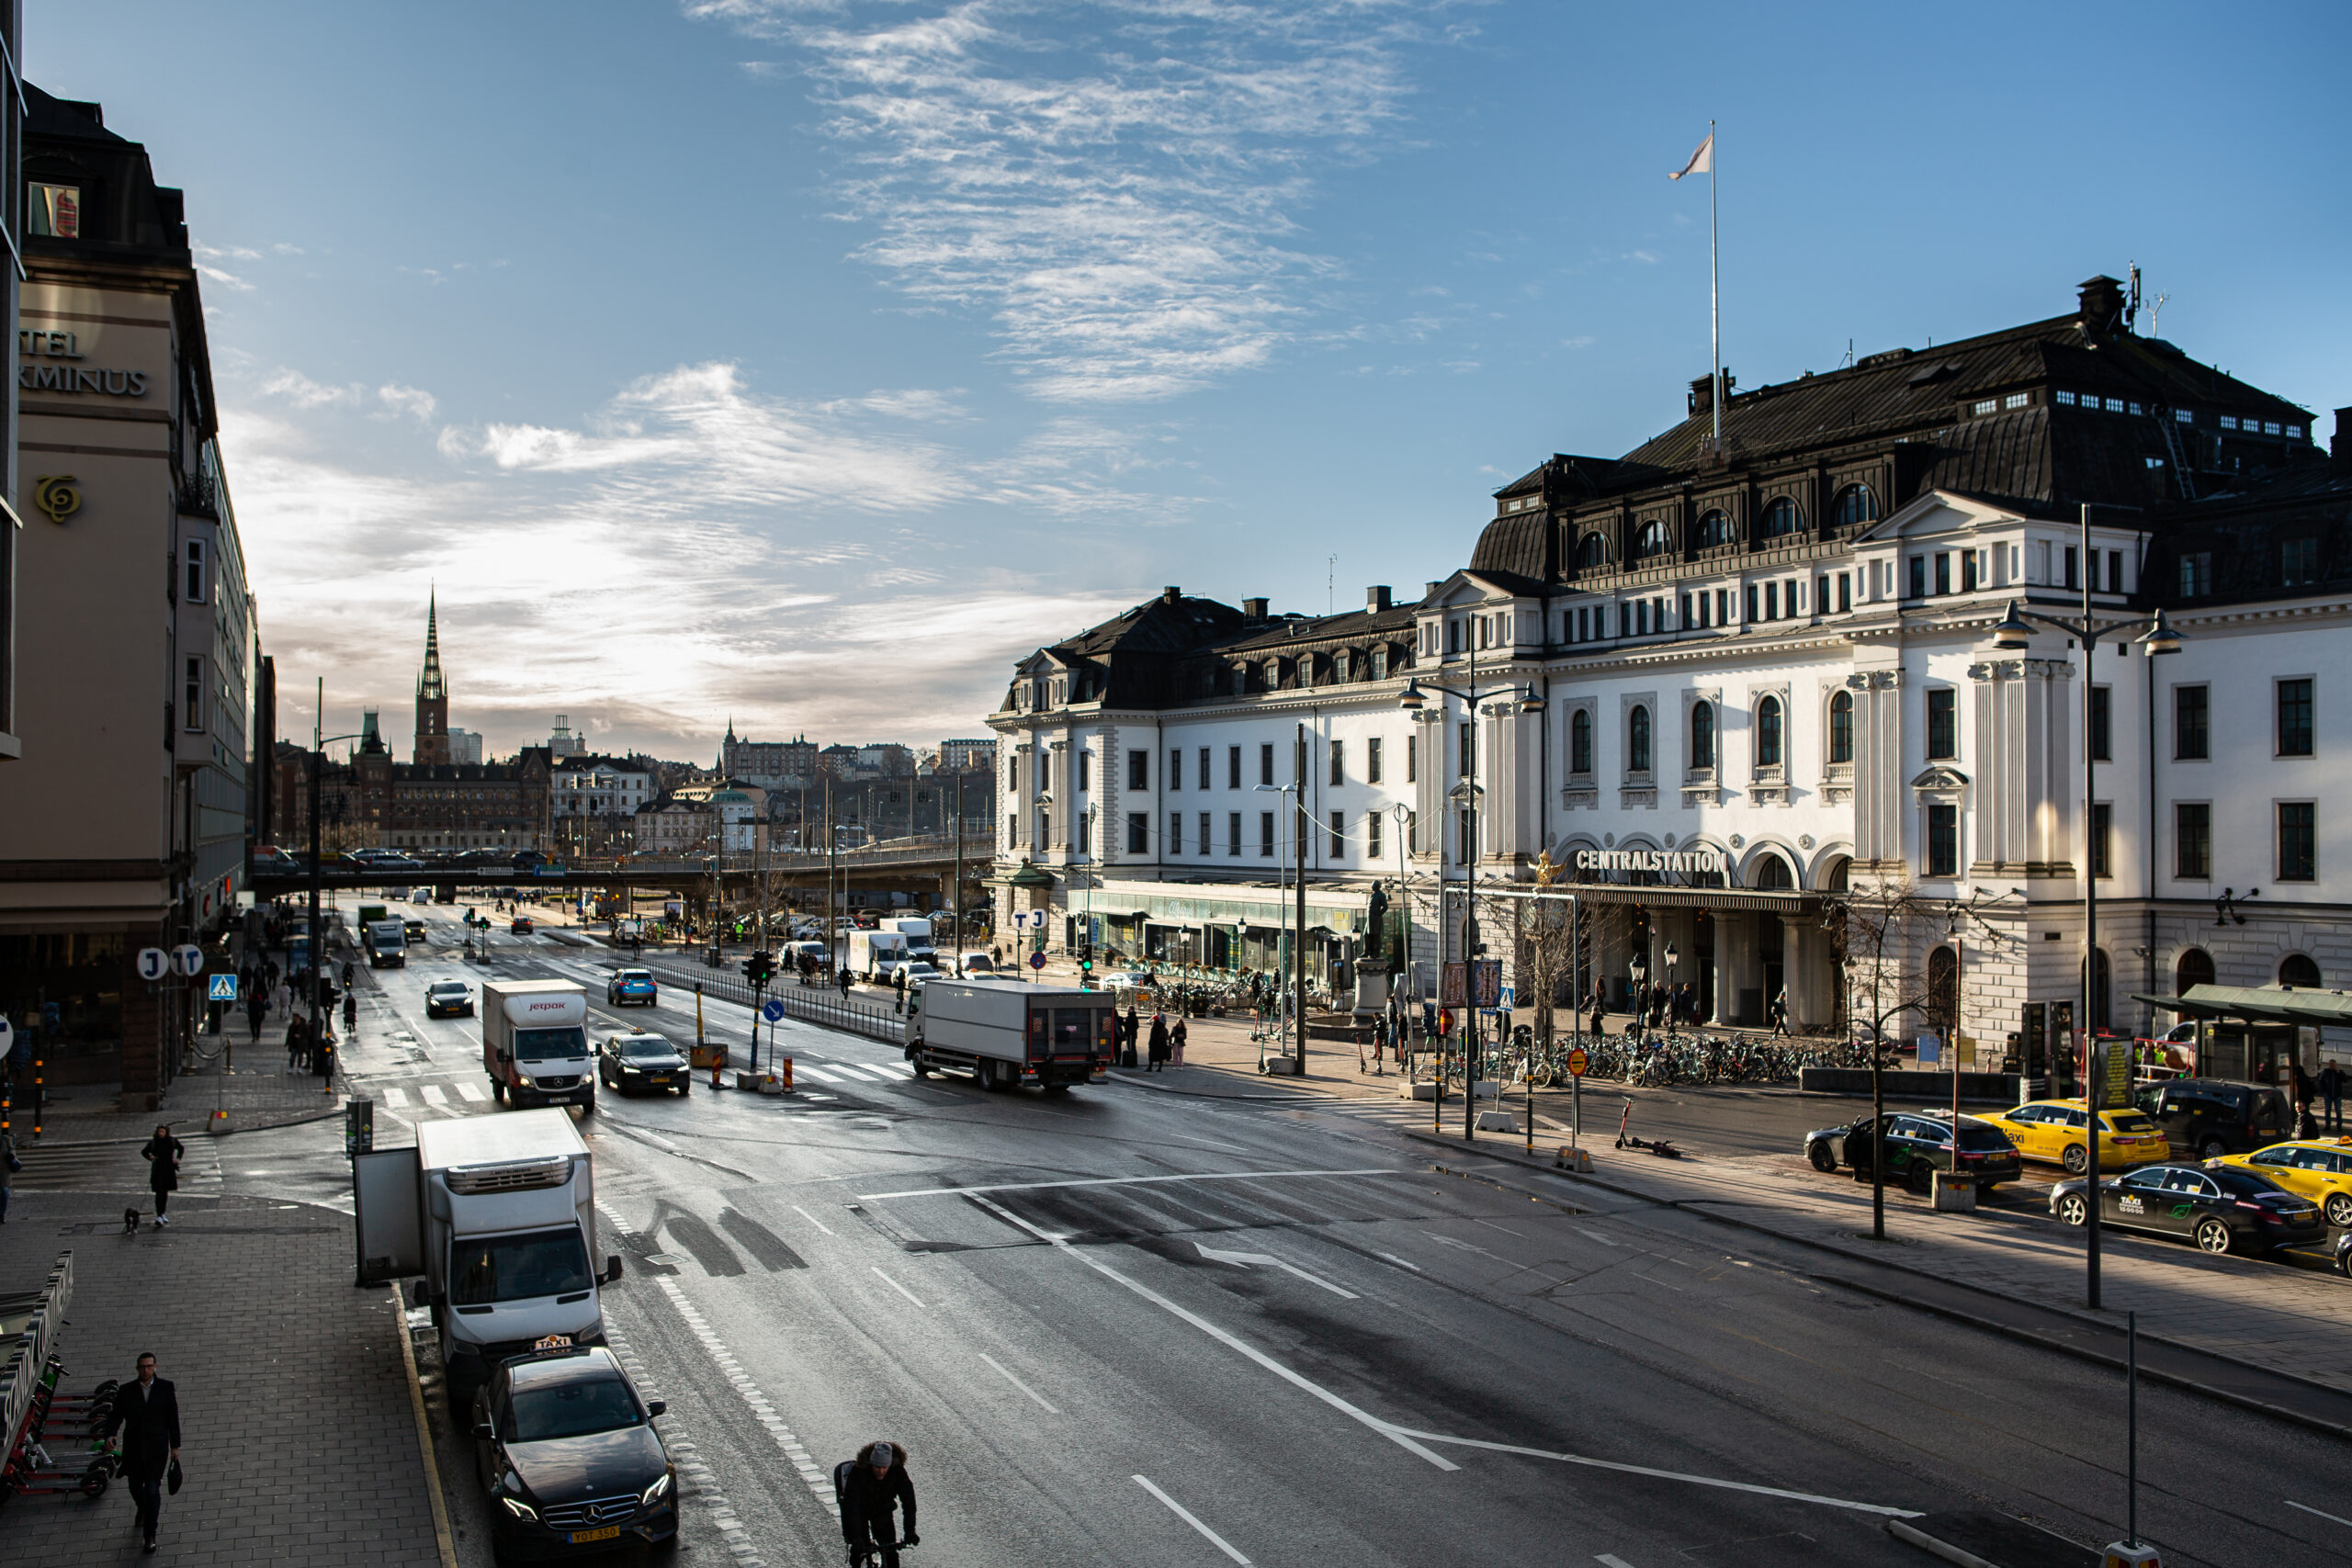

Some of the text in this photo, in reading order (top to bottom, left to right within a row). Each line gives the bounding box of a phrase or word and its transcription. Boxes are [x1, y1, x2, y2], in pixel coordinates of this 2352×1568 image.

[18, 329, 84, 359] TEL
[1576, 850, 1727, 873] CENTRALSTATION
[1014, 911, 1043, 928] T J
[144, 952, 159, 976] J
[186, 951, 199, 973] T
[529, 1002, 566, 1011] jetpak
[2120, 1196, 2142, 1206] TAXI
[538, 1337, 568, 1348] TAXI
[575, 1528, 616, 1540] YOT 350
